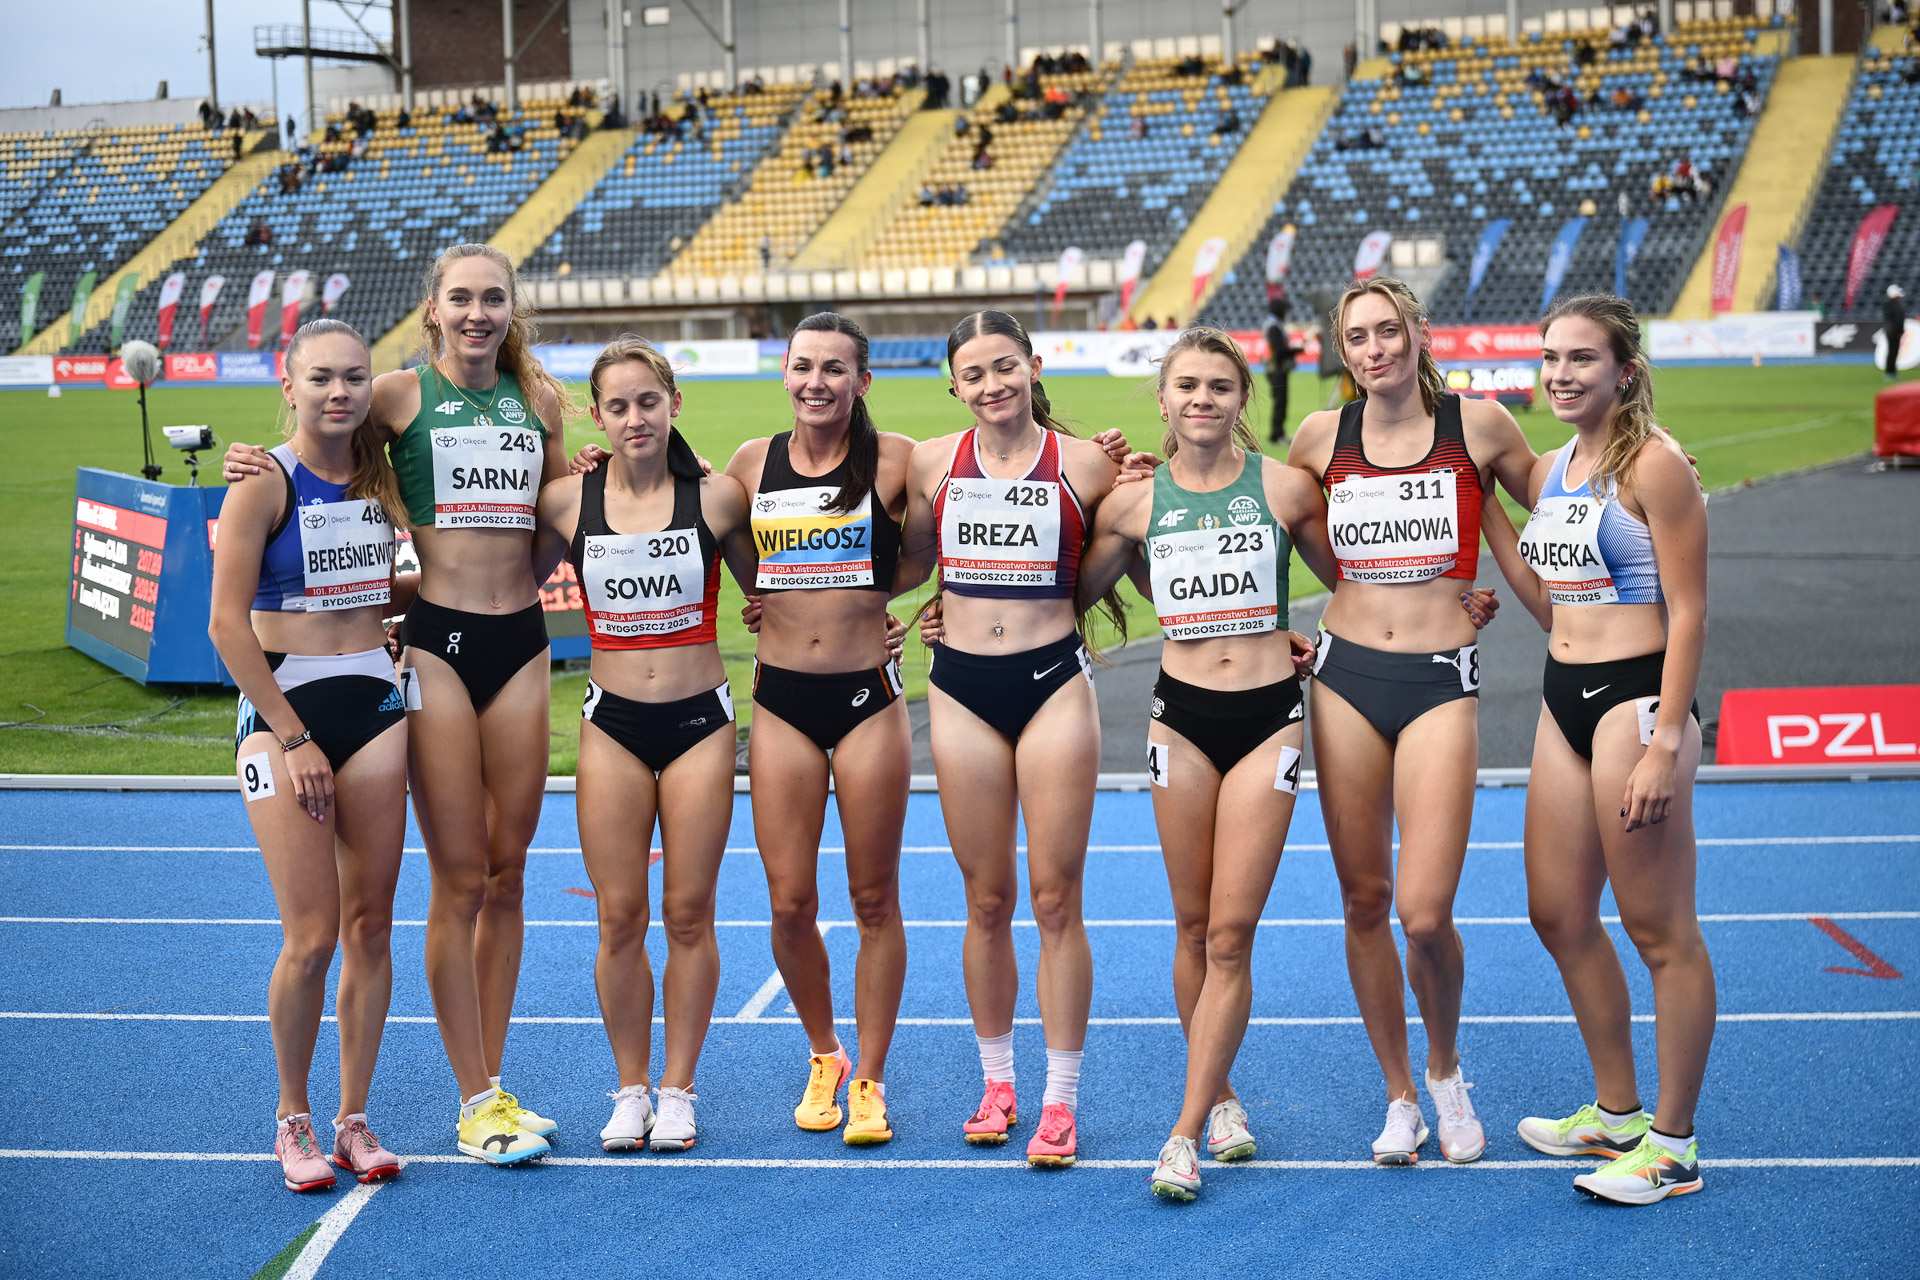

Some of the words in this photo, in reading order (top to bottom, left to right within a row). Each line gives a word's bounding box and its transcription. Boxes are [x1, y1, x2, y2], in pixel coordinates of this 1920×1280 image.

[73, 362, 106, 375] ORLEN
[172, 356, 217, 373] PZLA
[435, 401, 464, 415] 4F
[503, 401, 518, 409] AZS
[506, 411, 523, 419] AWF
[462, 438, 487, 446] Okęcie
[499, 432, 536, 453] 243
[452, 467, 530, 491] SARNA
[967, 492, 992, 500] Okęcie
[1004, 486, 1049, 506] 428
[1358, 490, 1385, 499] Okęcie
[1399, 479, 1444, 501] 311
[442, 504, 456, 512] 101.
[457, 504, 477, 512] PZLA
[478, 504, 524, 513] Mistrzostwa
[1235, 501, 1253, 509] AZS
[1566, 503, 1588, 524] 29
[331, 515, 351, 524] Okęcie
[451, 516, 514, 524] BYDGOSZCZ
[516, 516, 531, 525] 2025
[1157, 509, 1189, 527] 4F
[1235, 514, 1257, 522] AWF
[757, 526, 866, 552] WIELGOSZ
[958, 522, 1039, 547] BREZA
[1333, 517, 1453, 547] KOCZANOWA
[610, 548, 635, 556] Okęcie
[648, 535, 690, 558] 320
[1178, 544, 1204, 553] Okęcie
[1217, 531, 1263, 555] 223
[308, 541, 394, 574] BEREŚNIEWIC
[1354, 560, 1373, 569] PZLA
[1374, 557, 1425, 568] Mistrzostwa
[1427, 555, 1452, 564] Polski
[1520, 541, 1600, 571] PAJĘCKA
[775, 566, 792, 574] PZLA
[793, 564, 841, 574] Mistrzostwa
[842, 562, 866, 571] Polski
[959, 560, 975, 568] PZLA
[977, 560, 1027, 569] Mistrzostwa
[1028, 561, 1052, 570] Polski
[1351, 570, 1414, 580] BYDGOSZCZ
[1416, 566, 1443, 577] 2025
[770, 576, 831, 585] BYDGOSZCZ
[832, 574, 858, 583] 2025
[955, 571, 1015, 581] BYDGOSZCZ
[1017, 574, 1042, 582] 2025
[1582, 579, 1607, 589] Polski
[312, 587, 327, 596] 101.
[328, 585, 347, 595] PZLA
[348, 580, 389, 592] Mistrzostwa
[604, 574, 683, 600] SOWA
[1169, 570, 1259, 601] GAJDA
[322, 592, 381, 608] BYDGOSZCZ
[1576, 592, 1601, 602] 2025
[609, 613, 626, 621] PZLA
[627, 611, 675, 621] Mistrzostwa
[676, 605, 697, 616] Polski
[1162, 617, 1175, 625] 101.
[1175, 616, 1195, 624] PZLA
[1196, 611, 1248, 622] Mistrzostwa
[1249, 606, 1272, 616] Polski
[606, 623, 666, 633] BYDGOSZCZ
[667, 617, 690, 629] 2025
[1171, 624, 1237, 637] BYDGOSZCZ
[1239, 620, 1264, 630] 2025
[1469, 647, 1480, 686] 8
[400, 671, 411, 708] 7
[378, 699, 405, 712] adida
[1767, 712, 1920, 759] PZL
[1148, 745, 1161, 782] 4
[1283, 753, 1301, 791] 4
[245, 763, 269, 793] 9.
